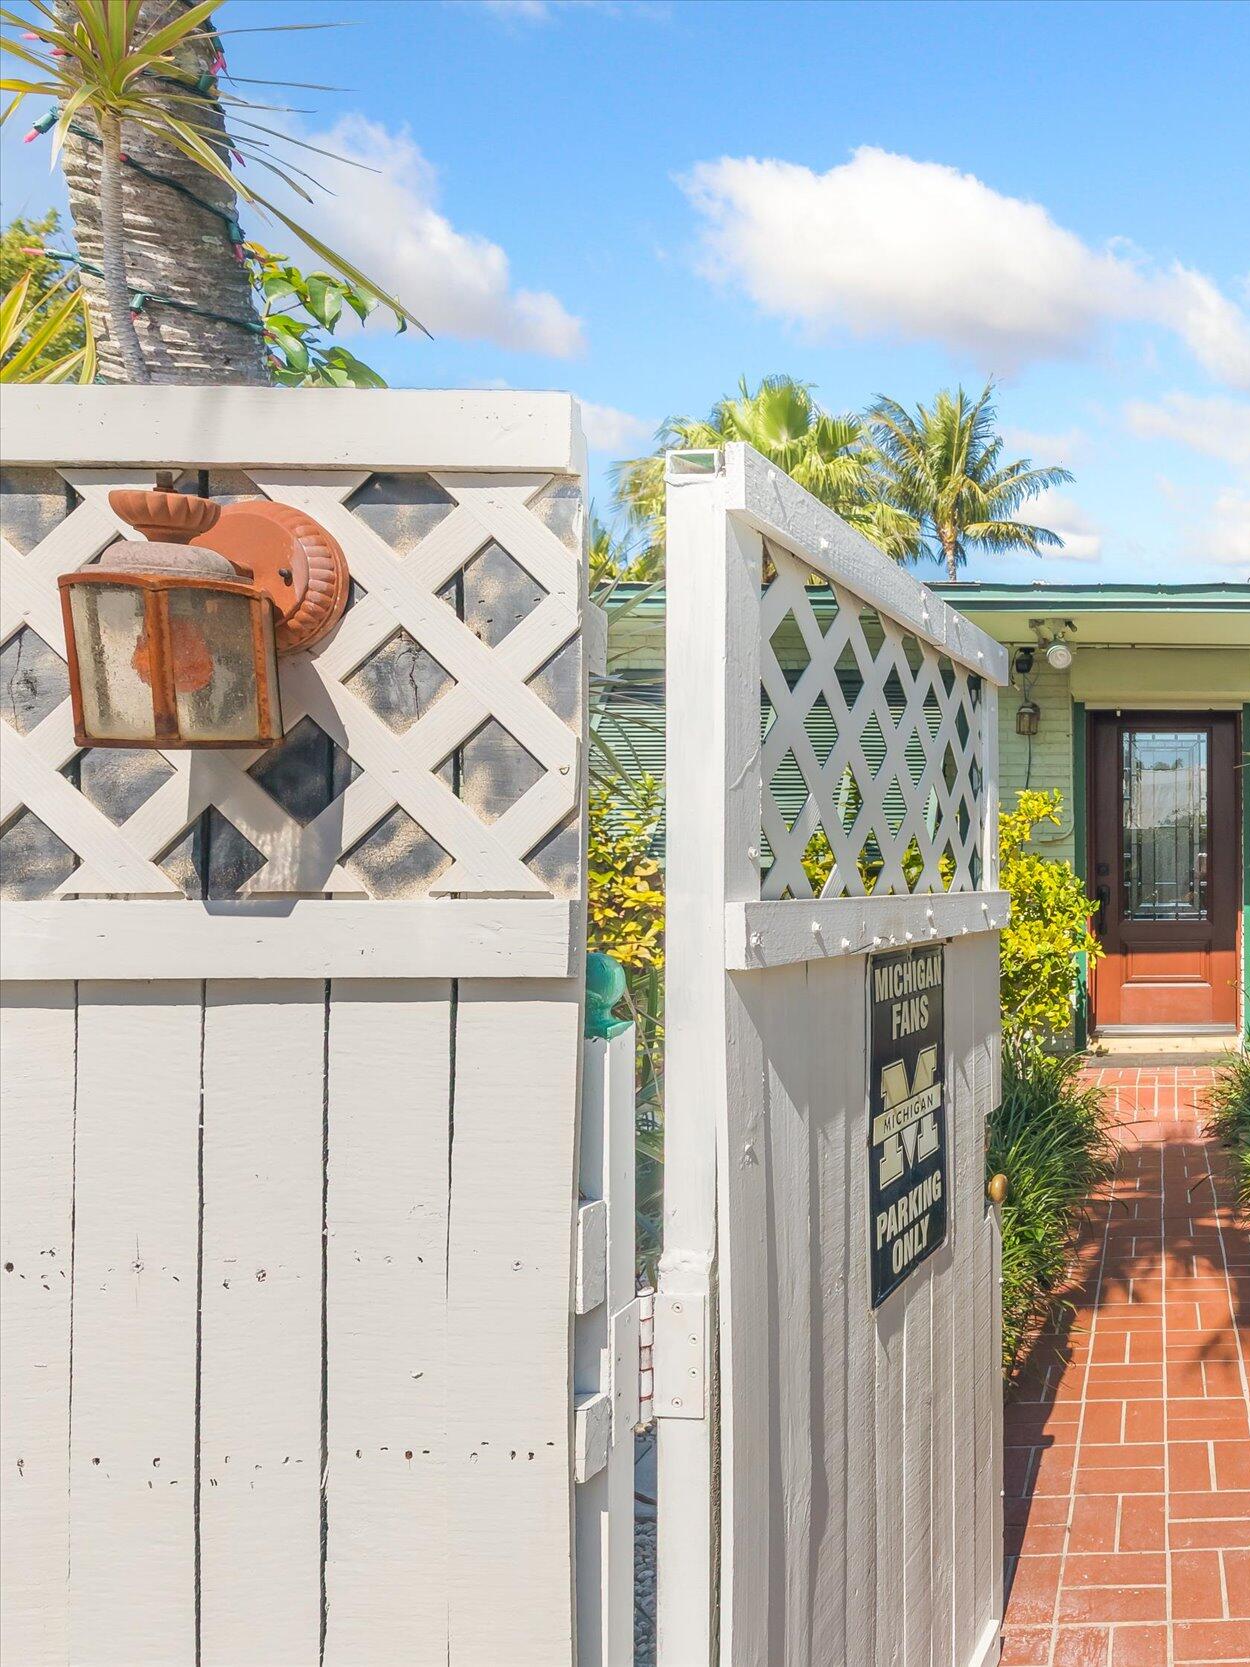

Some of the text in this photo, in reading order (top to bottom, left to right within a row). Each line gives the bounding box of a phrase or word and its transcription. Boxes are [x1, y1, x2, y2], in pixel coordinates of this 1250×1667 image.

[874, 955, 942, 1003] MICHIGAN
[892, 994, 929, 1040] FANS
[879, 1044, 941, 1190] M
[883, 1093, 934, 1134] MICHIGAN
[876, 1170, 942, 1250] PARKING
[892, 1214, 930, 1274] ONLY
